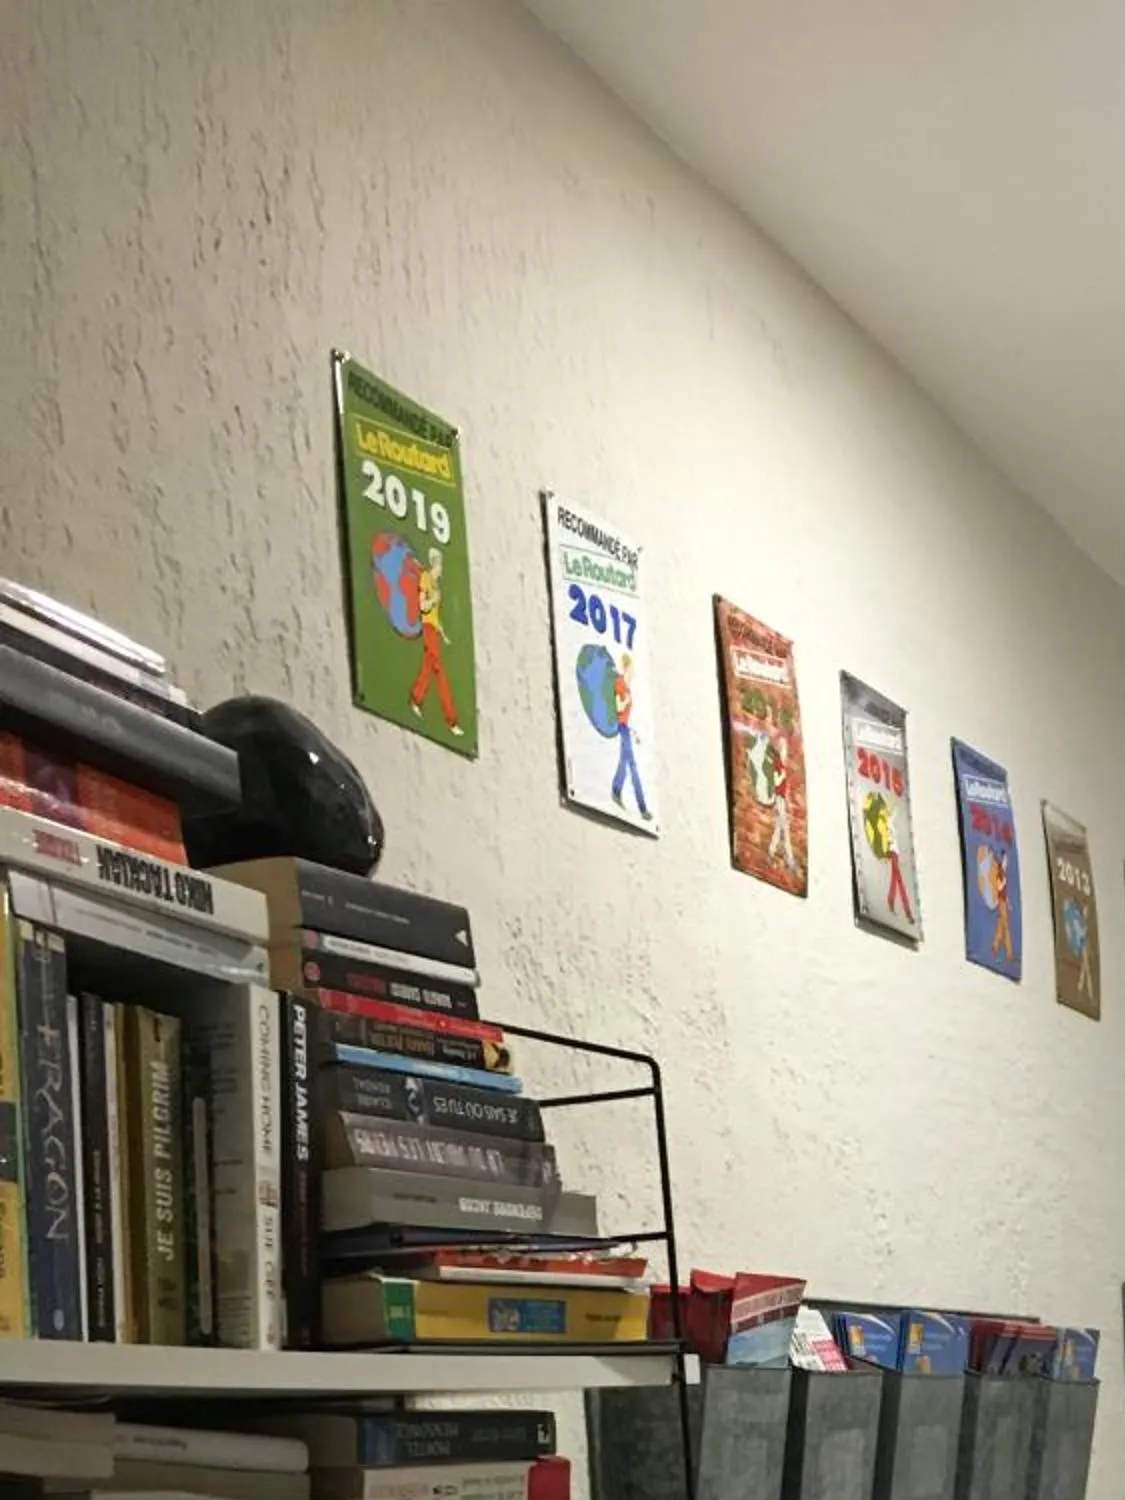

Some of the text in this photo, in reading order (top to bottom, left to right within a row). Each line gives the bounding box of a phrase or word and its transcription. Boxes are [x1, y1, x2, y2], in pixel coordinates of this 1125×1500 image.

[362, 460, 450, 543] 2019
[568, 584, 636, 651] 2017
[292, 1003, 307, 1080] PETER
[35, 1024, 70, 1239] ERAGON
[151, 1061, 174, 1261] JE SUIS PILGRIM
[295, 1081, 309, 1161] JAMES
